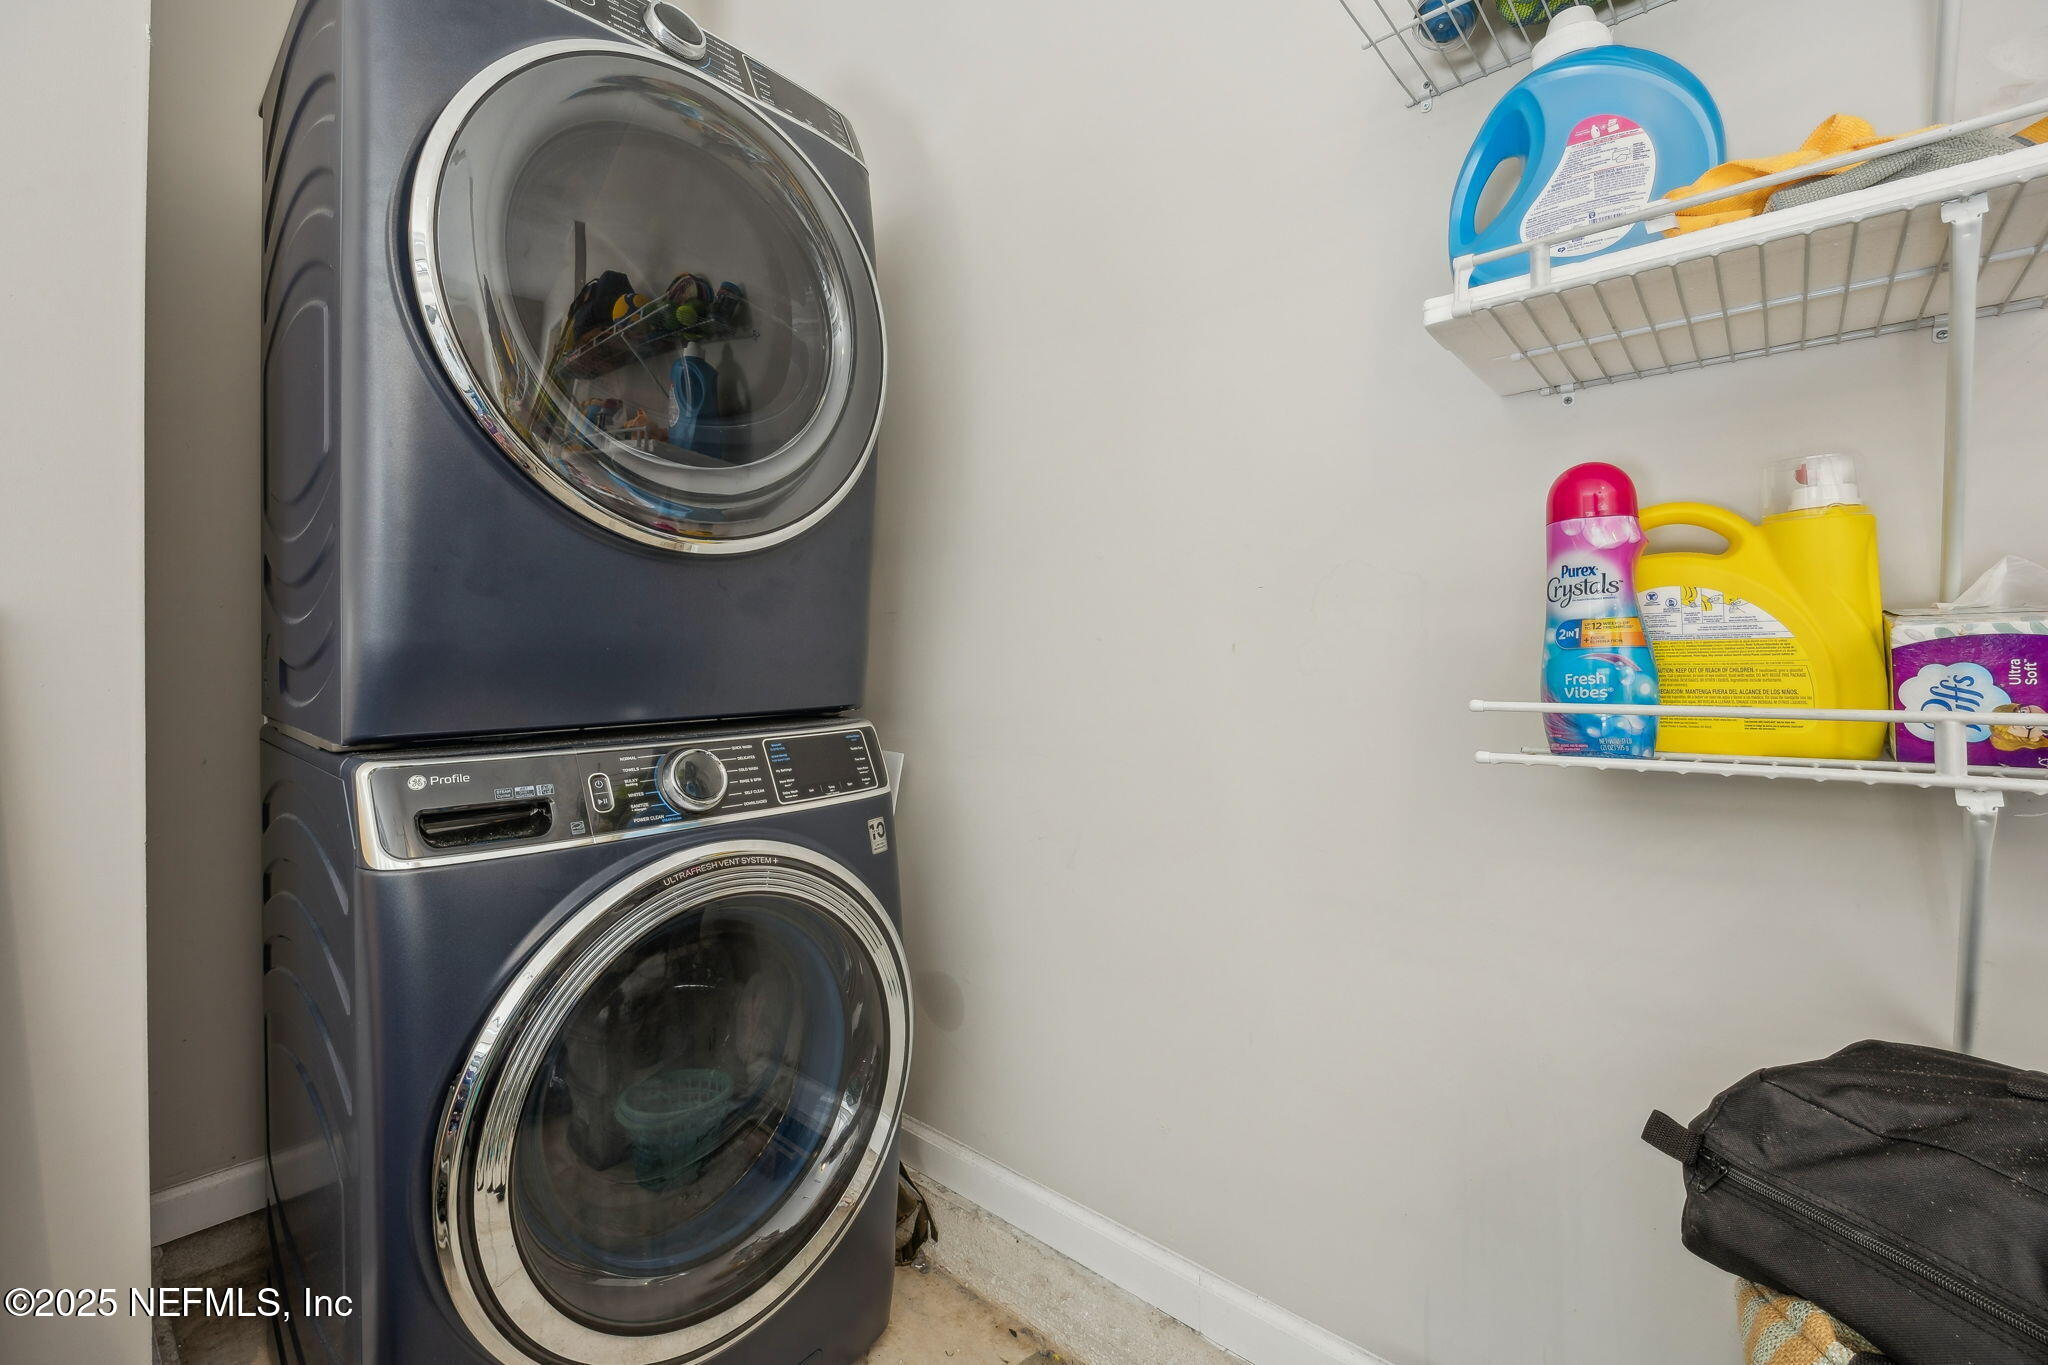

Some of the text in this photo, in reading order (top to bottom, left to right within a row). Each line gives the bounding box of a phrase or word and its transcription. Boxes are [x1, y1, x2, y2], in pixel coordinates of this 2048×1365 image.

[1561, 565, 1597, 578] Purex
[1547, 573, 1620, 608] Crystals
[1592, 622, 1602, 630] 12
[2008, 658, 2021, 685] Ultra
[2024, 661, 2038, 685] Soft
[1565, 672, 1606, 686] Fresh
[1565, 687, 1608, 699] Vibes
[430, 774, 470, 785] Profile
[663, 860, 718, 886] ULTRAFRESH
[719, 858, 740, 867] VENT
